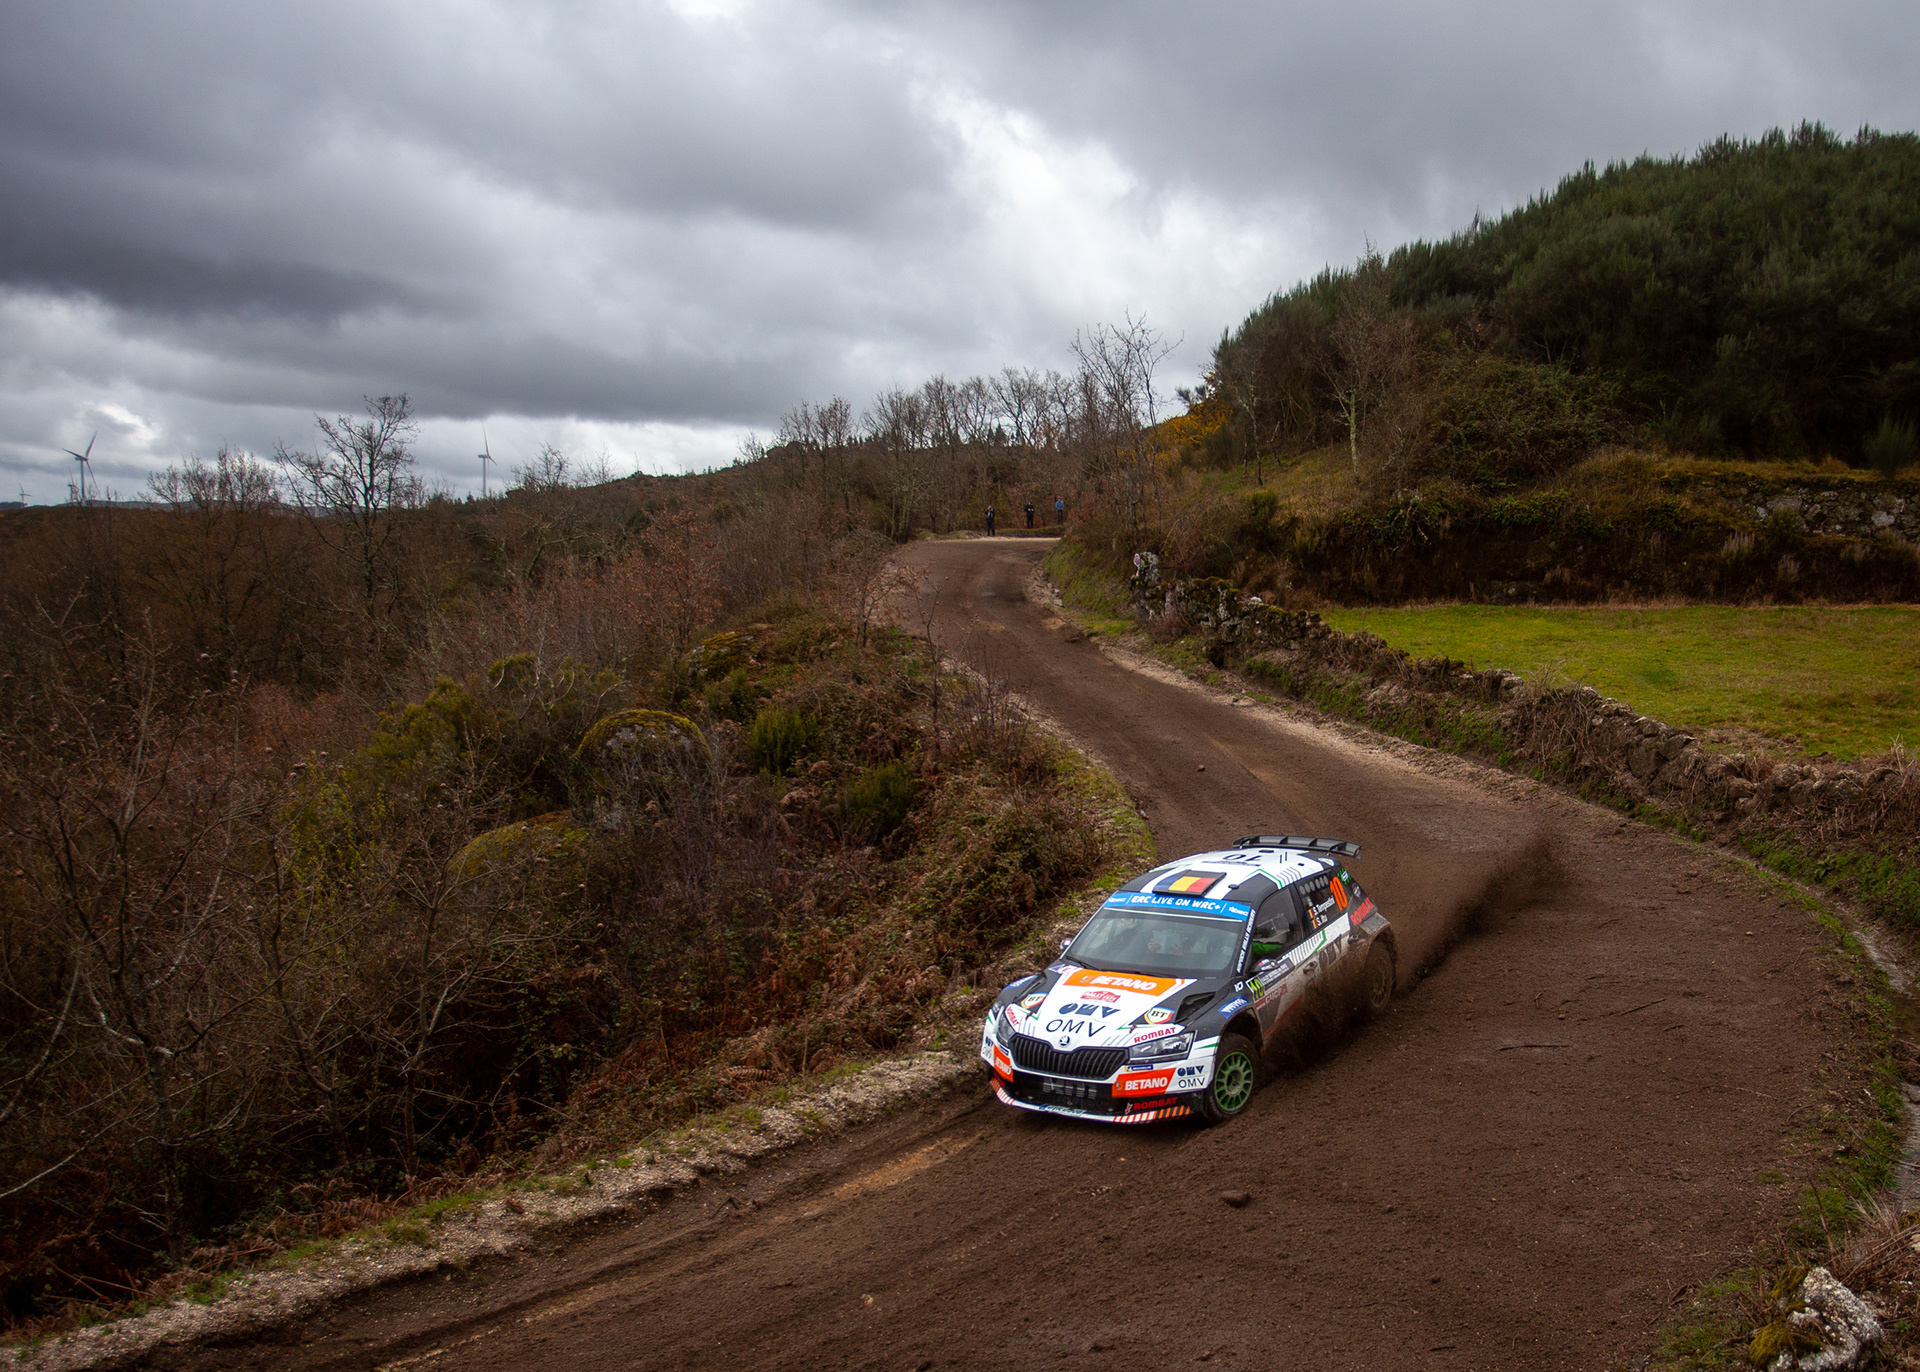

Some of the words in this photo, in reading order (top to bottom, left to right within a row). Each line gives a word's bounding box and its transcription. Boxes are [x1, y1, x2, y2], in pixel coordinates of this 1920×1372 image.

[1330, 876, 1348, 911] 10
[1131, 894, 1152, 904] ERC
[1151, 896, 1173, 905] LIVE
[1175, 898, 1189, 907] ON
[1192, 900, 1221, 910] WRC+
[1350, 897, 1374, 926] ROMBAT
[1091, 975, 1157, 990] BETANO
[1250, 978, 1263, 1000] 10
[1151, 1010, 1168, 1018] BT
[1046, 1019, 1106, 1037] OMV
[1134, 1027, 1176, 1043] ROMBAT
[1125, 1077, 1168, 1091] BETANO
[1178, 1078, 1205, 1088] OMV
[1133, 1097, 1178, 1110] ROMBAT
